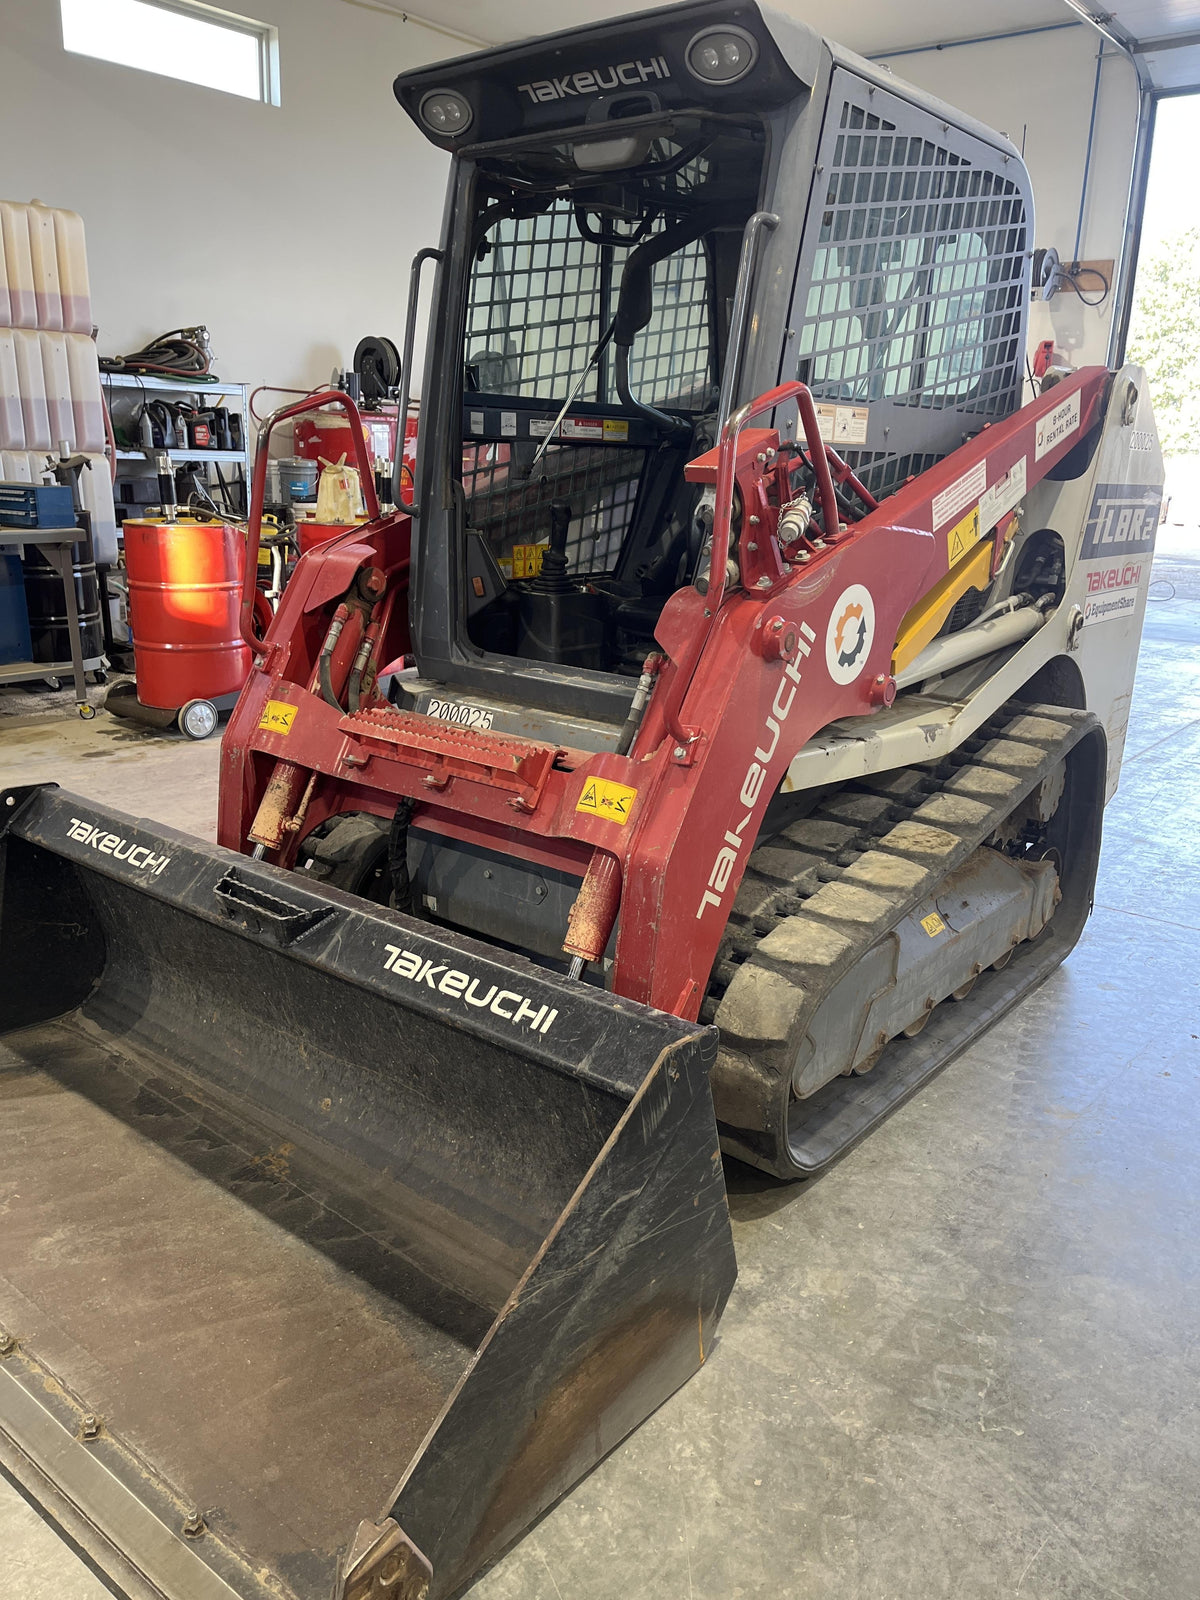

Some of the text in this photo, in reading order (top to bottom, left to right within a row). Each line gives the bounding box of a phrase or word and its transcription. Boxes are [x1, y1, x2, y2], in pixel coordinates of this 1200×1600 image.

[517, 55, 672, 104] TAKEUCHI
[1046, 412, 1078, 445] RENTAL RATE
[1086, 565, 1142, 592] TAKEUCHI
[1090, 597, 1135, 618] EquipmentShare
[428, 700, 493, 730] 200025
[696, 620, 818, 920] TAKEUCHI
[65, 818, 171, 877] TAKEUCHI
[383, 943, 560, 1035] TAKEUCHI
